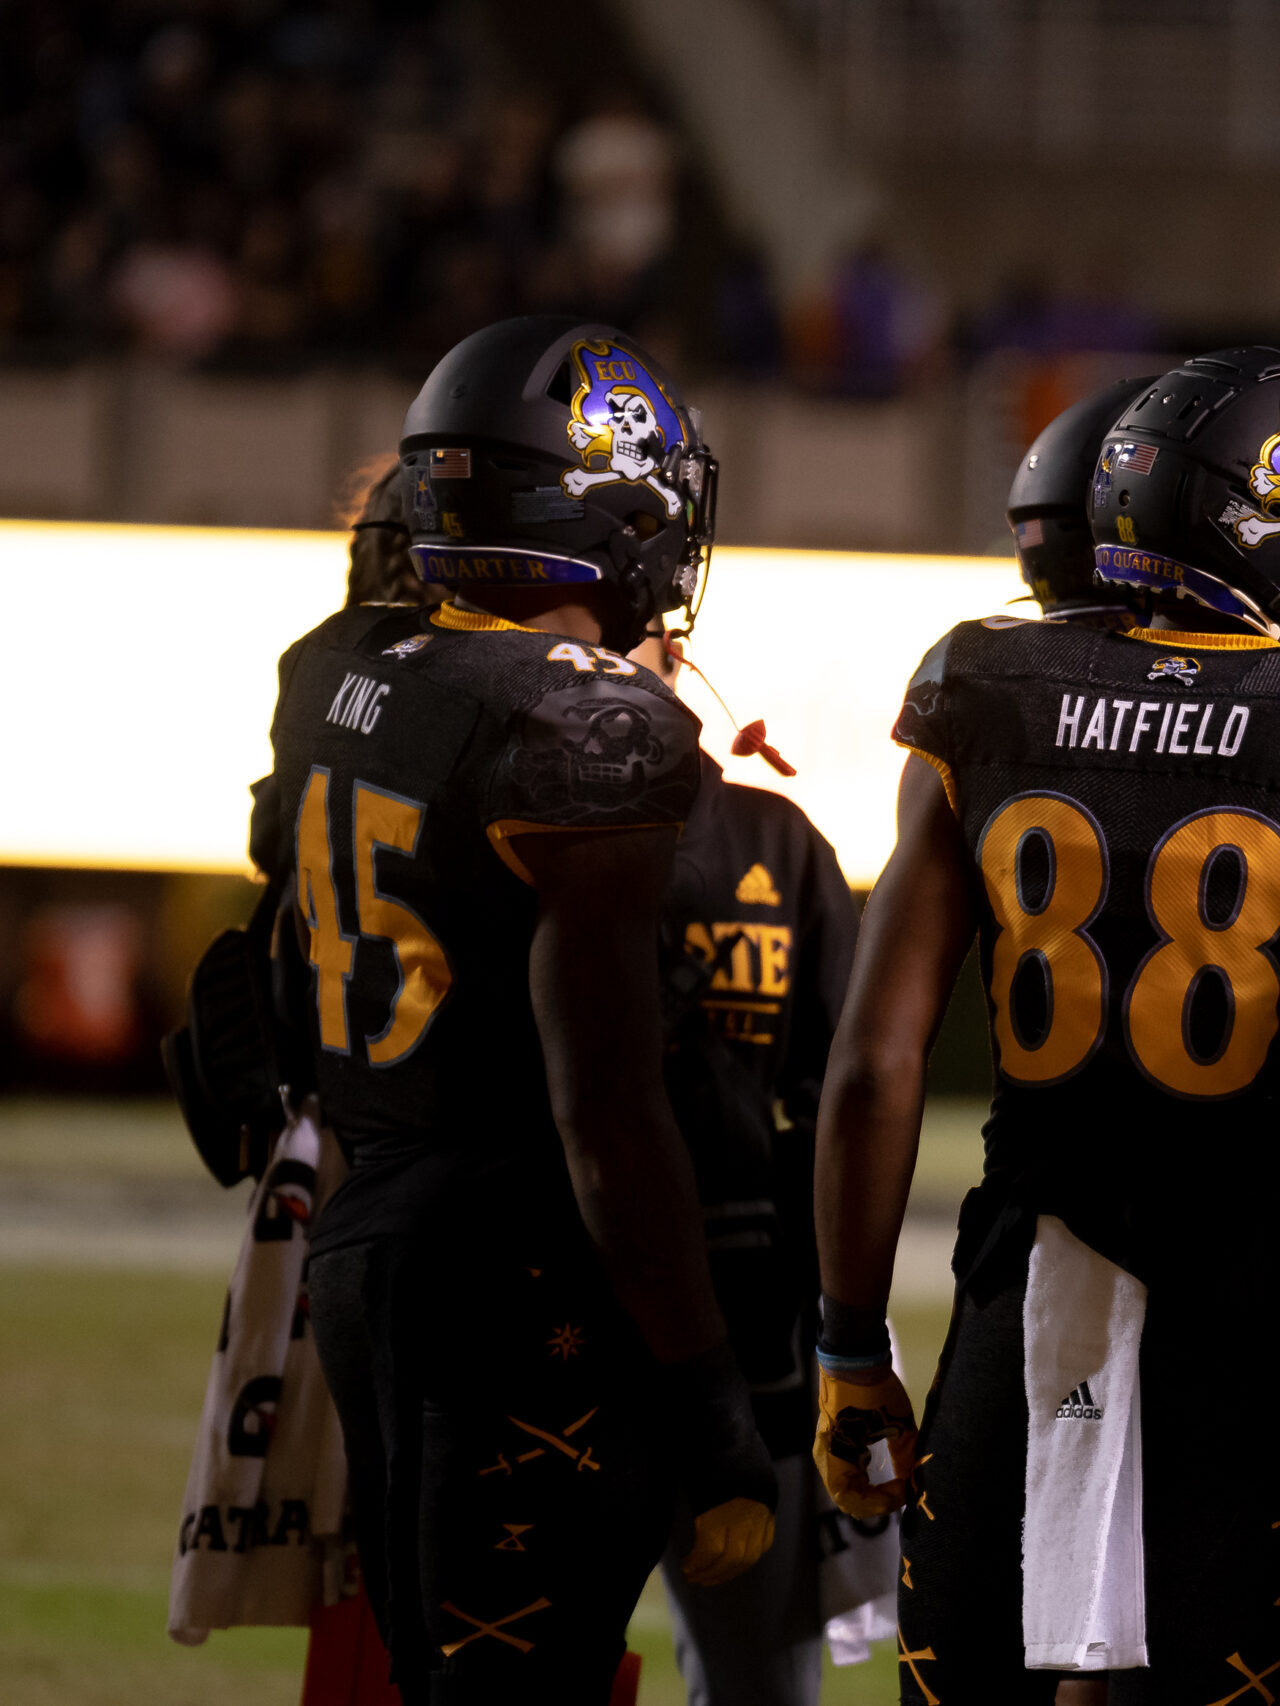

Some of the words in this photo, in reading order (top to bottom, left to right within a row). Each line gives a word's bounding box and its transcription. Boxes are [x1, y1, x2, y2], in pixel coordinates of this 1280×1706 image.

[594, 361, 636, 381] ECU
[1116, 515, 1137, 543] 88
[428, 555, 549, 580] QUARTER
[1113, 551, 1185, 583] QUARTER
[546, 643, 637, 676] 45
[325, 671, 391, 735] KING
[1054, 693, 1250, 758] HATFIELD
[294, 763, 458, 1070] 45
[1055, 1404, 1102, 1420] adidas
